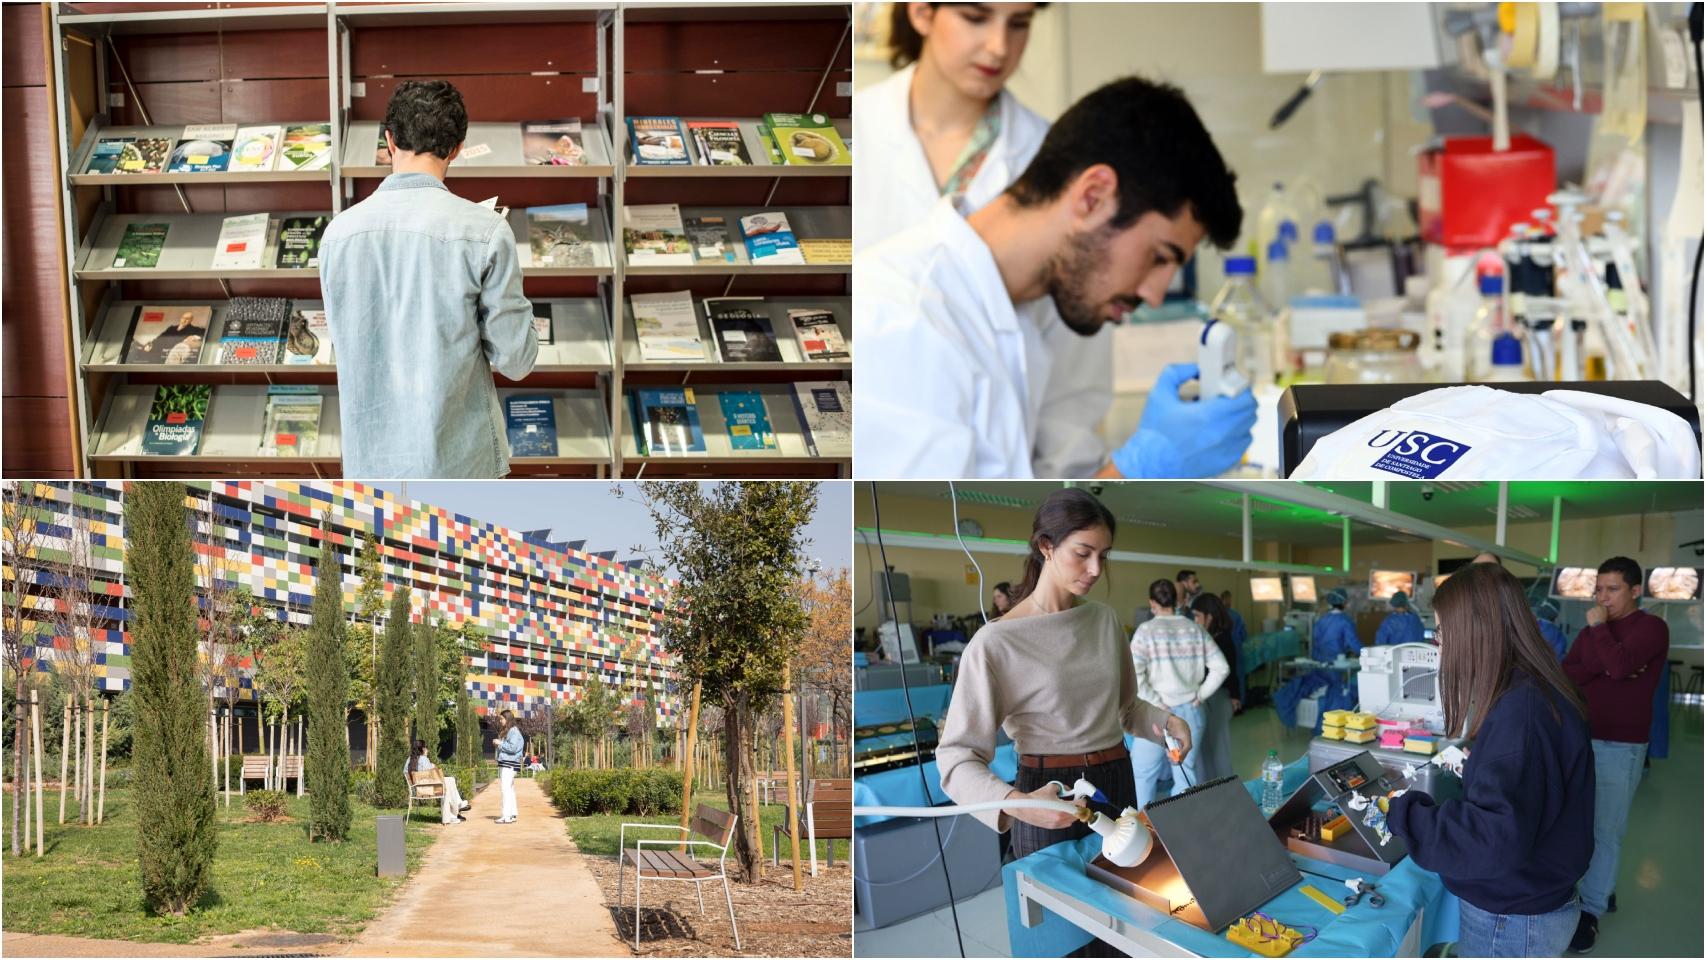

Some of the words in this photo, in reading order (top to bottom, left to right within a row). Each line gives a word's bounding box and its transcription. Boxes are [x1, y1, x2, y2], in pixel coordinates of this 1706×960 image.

[152, 424, 196, 435] Olimpiadas
[1367, 429, 1460, 465] USC
[1387, 452, 1431, 469] UNIVERSIDADE
[1391, 461, 1423, 473] SANTIAGO
